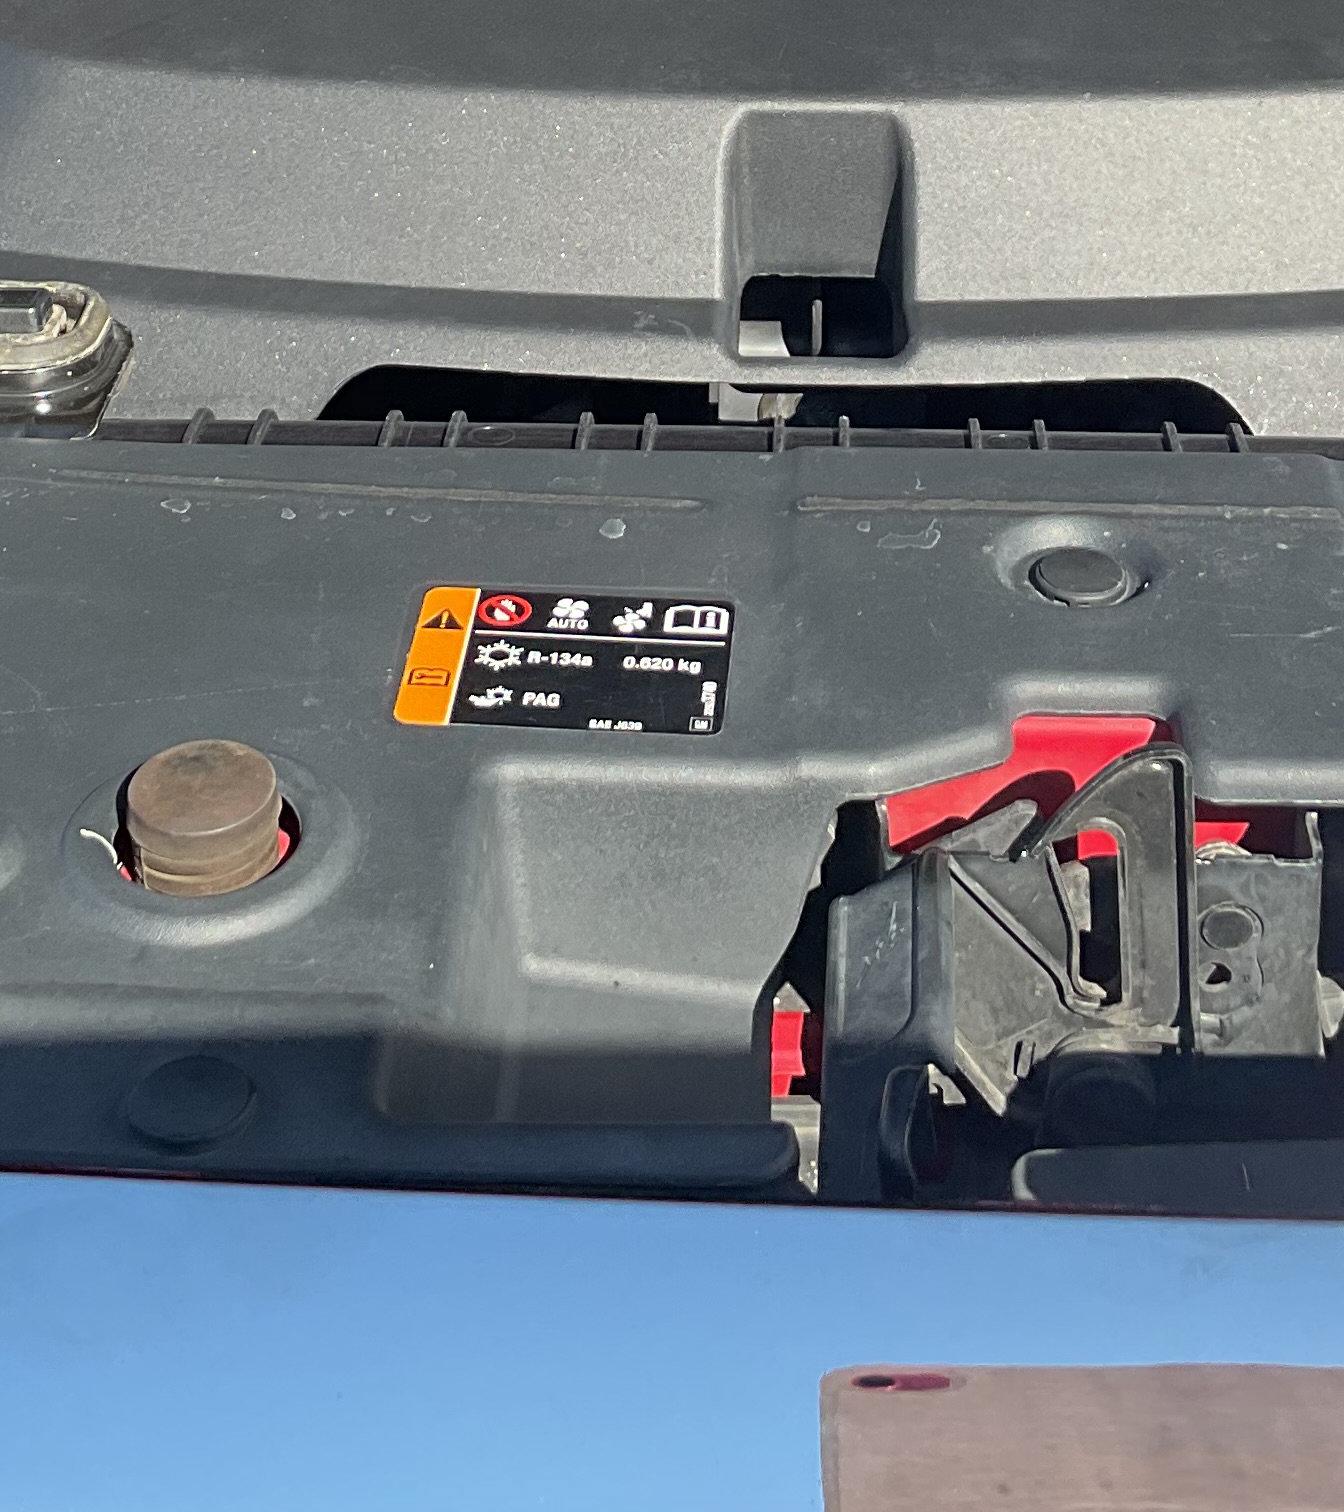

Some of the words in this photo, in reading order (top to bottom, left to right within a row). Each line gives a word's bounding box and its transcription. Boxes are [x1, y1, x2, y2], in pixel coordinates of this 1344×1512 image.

[546, 617, 589, 630] AUTO
[527, 650, 593, 667] R-134a
[623, 655, 674, 671] 0.620
[678, 657, 702, 675] kg
[522, 691, 561, 707] PAG
